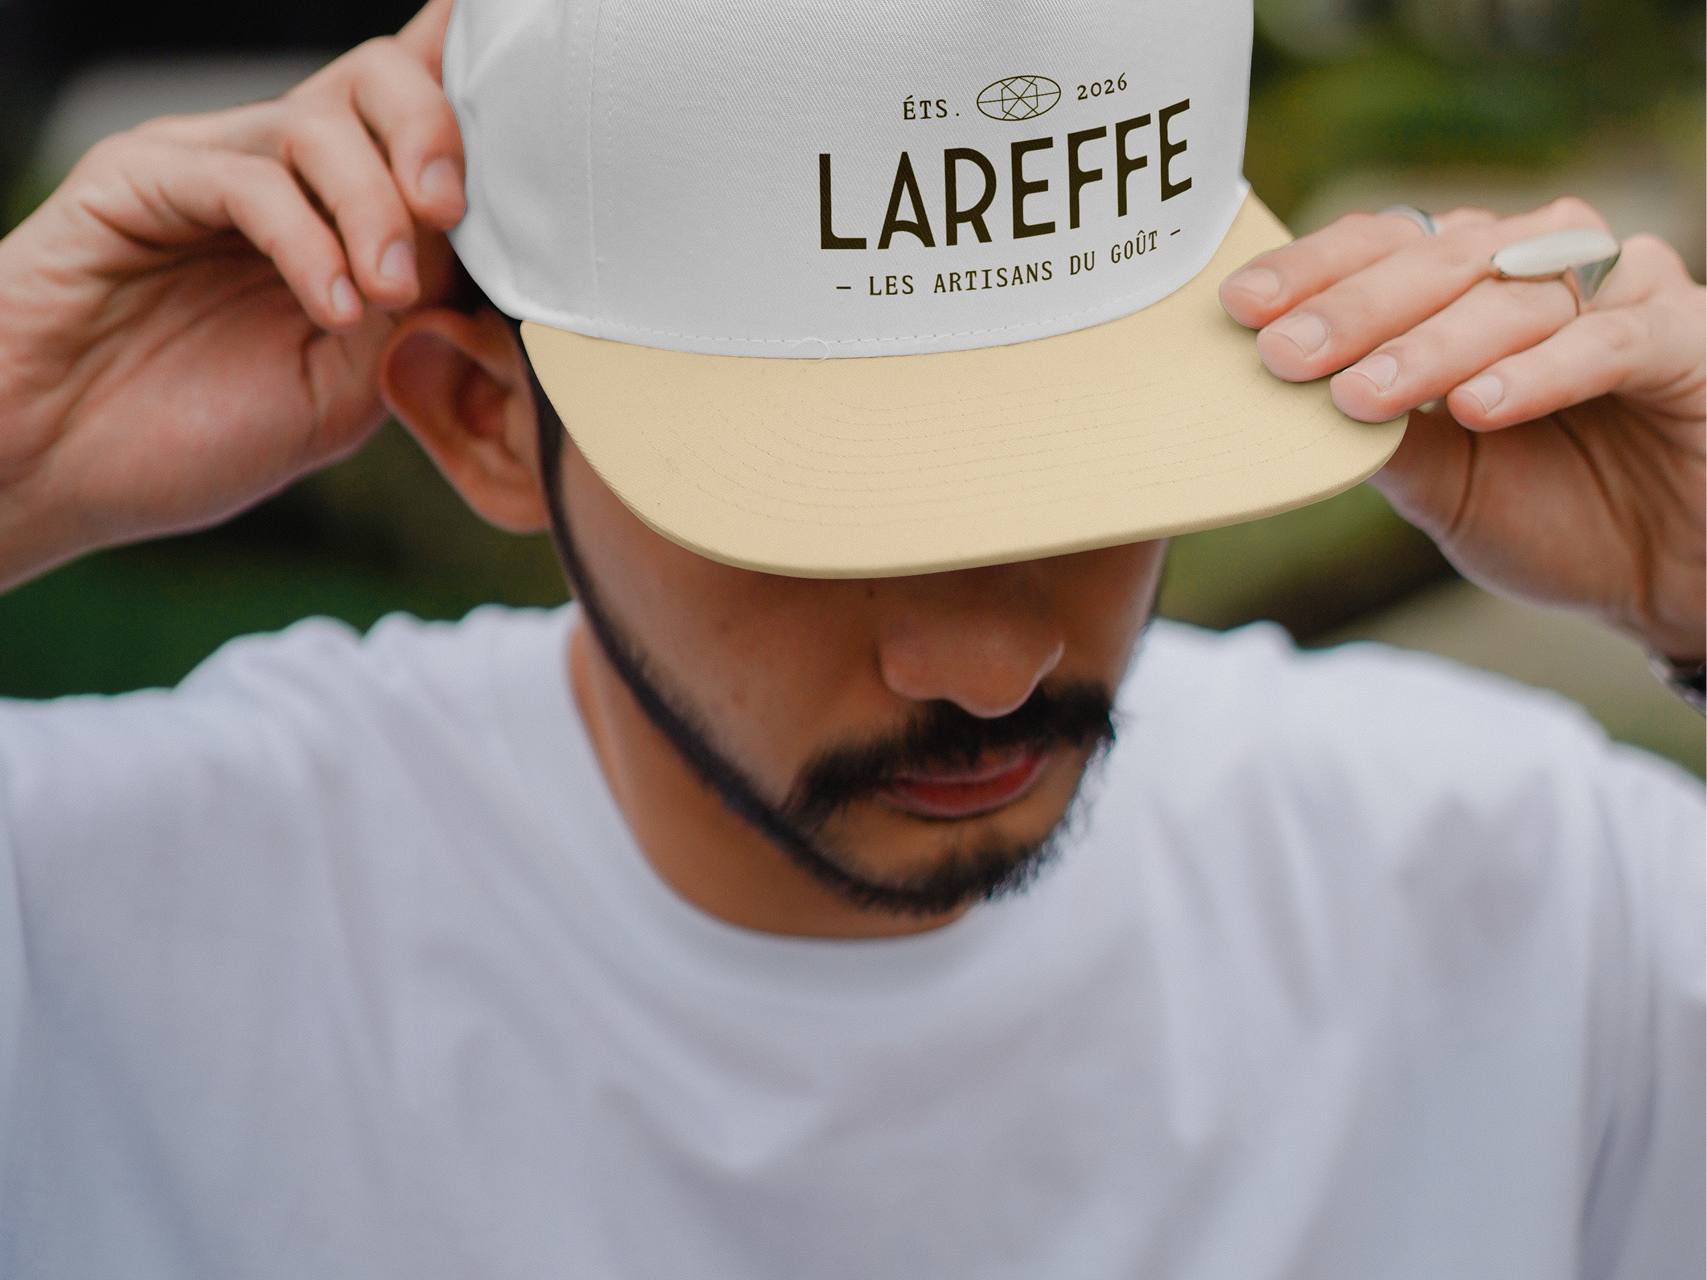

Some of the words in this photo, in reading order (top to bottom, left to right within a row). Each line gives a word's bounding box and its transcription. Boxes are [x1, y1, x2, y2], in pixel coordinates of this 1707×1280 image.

[902, 94, 960, 121] ÉTS.
[1076, 71, 1128, 101] 2026
[818, 97, 1193, 251] LAREFFE
[868, 275, 915, 296] LES
[933, 260, 1053, 294] ARTISANS
[1069, 250, 1095, 276] DU
[1110, 229, 1158, 264] GOÛT
